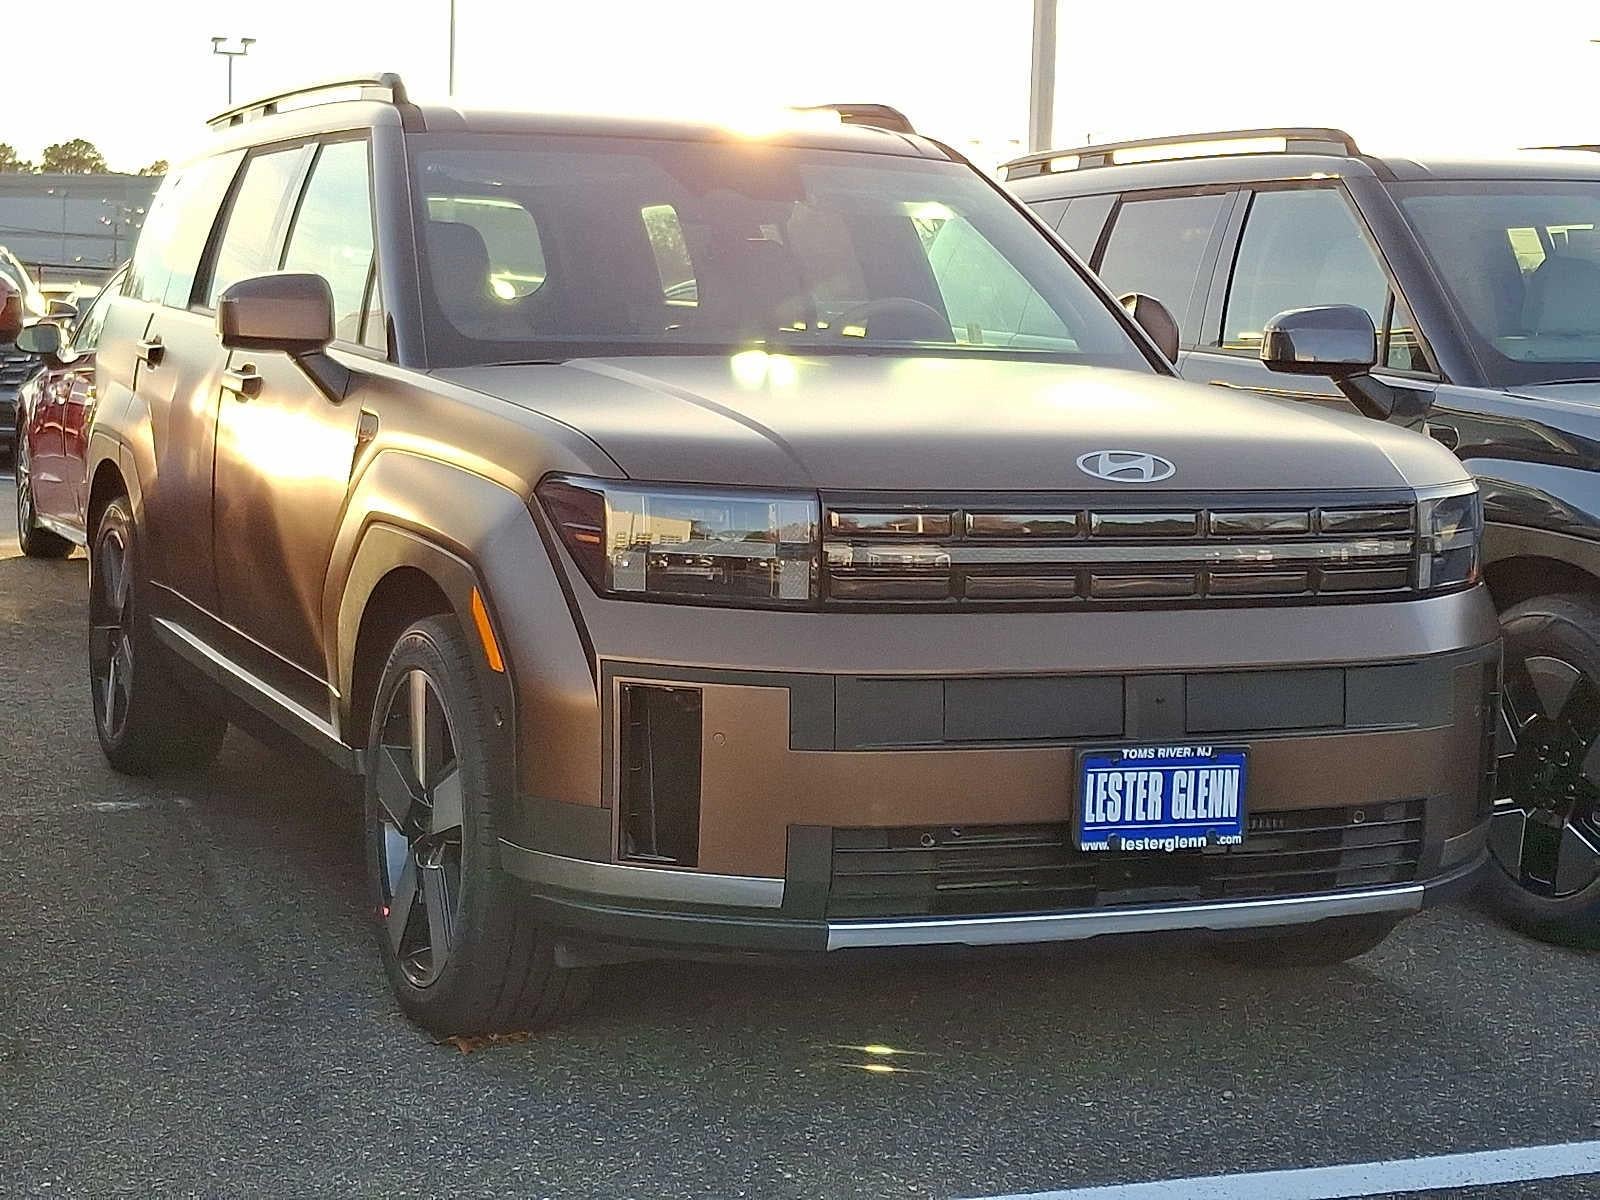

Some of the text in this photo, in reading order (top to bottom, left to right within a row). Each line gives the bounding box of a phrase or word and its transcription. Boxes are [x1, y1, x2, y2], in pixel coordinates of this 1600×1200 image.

[1122, 748, 1155, 759] TOMS
[1196, 746, 1213, 757] NJ
[1085, 768, 1239, 823] LESTER GLENN
[1120, 836, 1207, 852] lesterglenn
